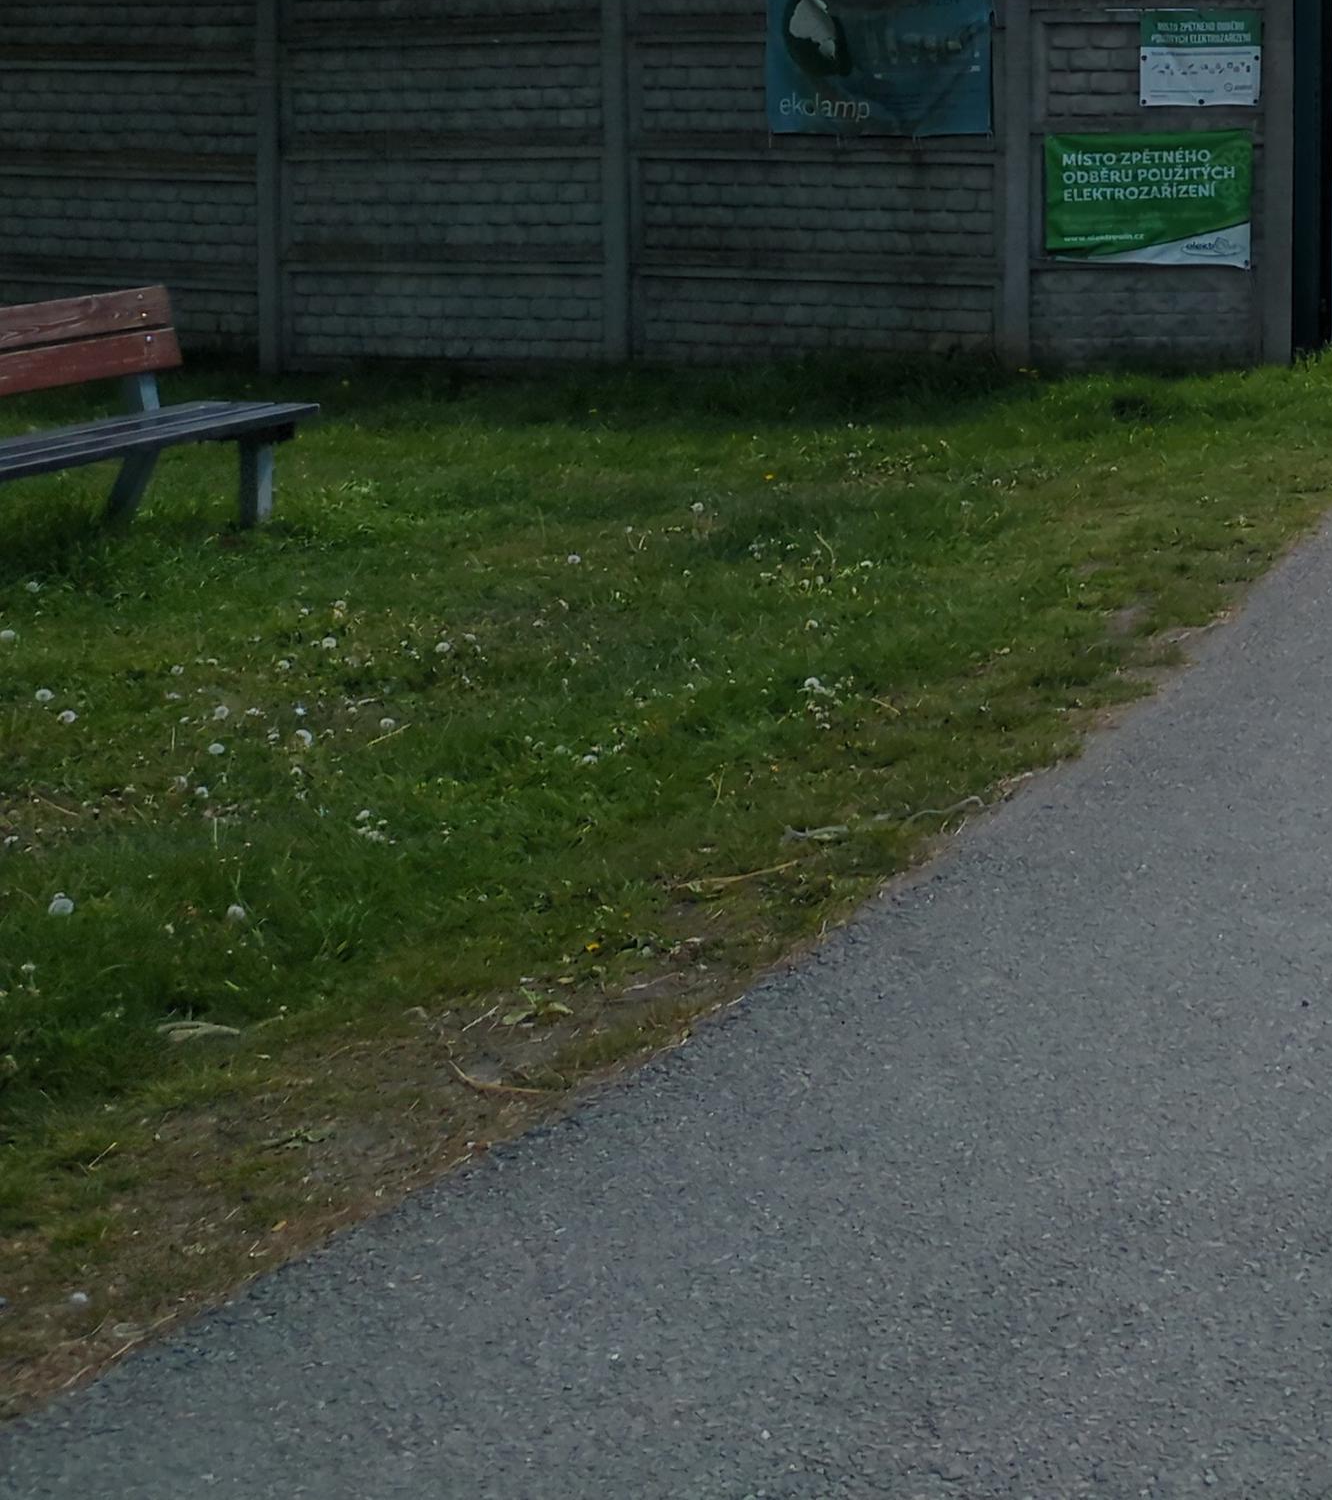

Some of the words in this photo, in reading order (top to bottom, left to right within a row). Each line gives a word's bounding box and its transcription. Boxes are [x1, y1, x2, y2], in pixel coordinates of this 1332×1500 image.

[779, 92, 870, 122] ekolamp
[1062, 150, 1117, 166] MÍSTO
[1121, 147, 1211, 165] ZPĚTNÉHO
[1062, 168, 1132, 184] ODBĚRU
[1137, 165, 1236, 182] POUŽITÝCH
[1063, 181, 1216, 202] ELEKTROZAŘÍZENÍ
